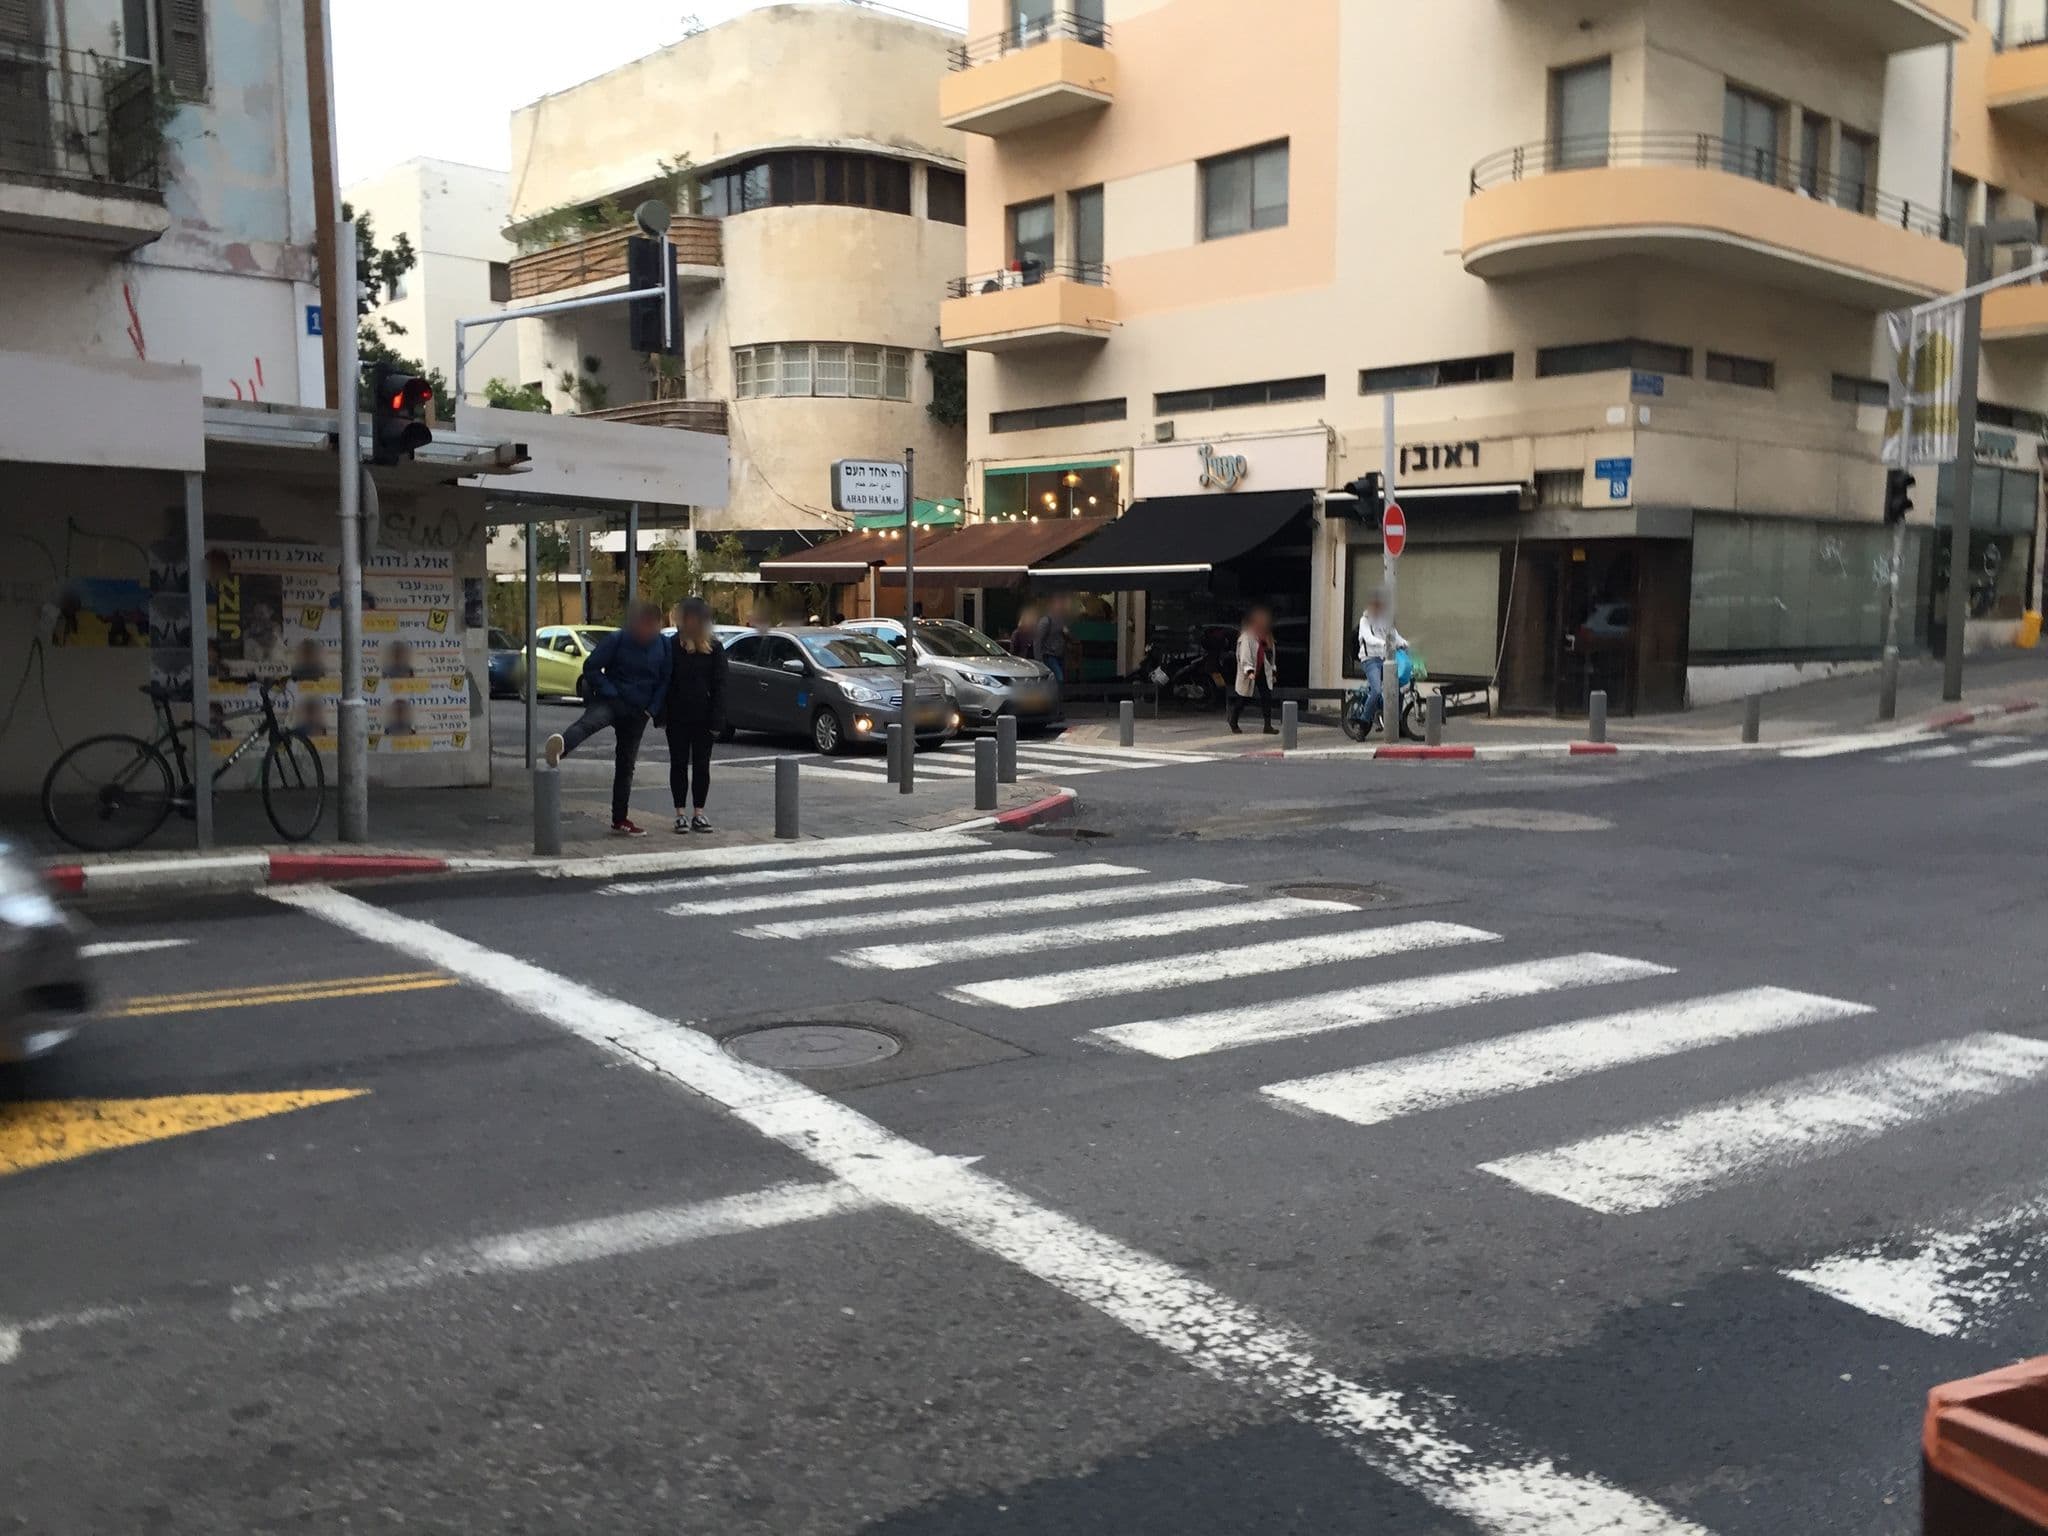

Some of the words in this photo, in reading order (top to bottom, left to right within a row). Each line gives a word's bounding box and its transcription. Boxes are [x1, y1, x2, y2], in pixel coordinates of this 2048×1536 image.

[1400, 441, 1480, 486] ראובן
[845, 466, 866, 477] העם
[868, 466, 888, 477] אחד
[846, 494, 867, 504] AHAD
[286, 548, 324, 562] אולג
[414, 555, 449, 568] אולג
